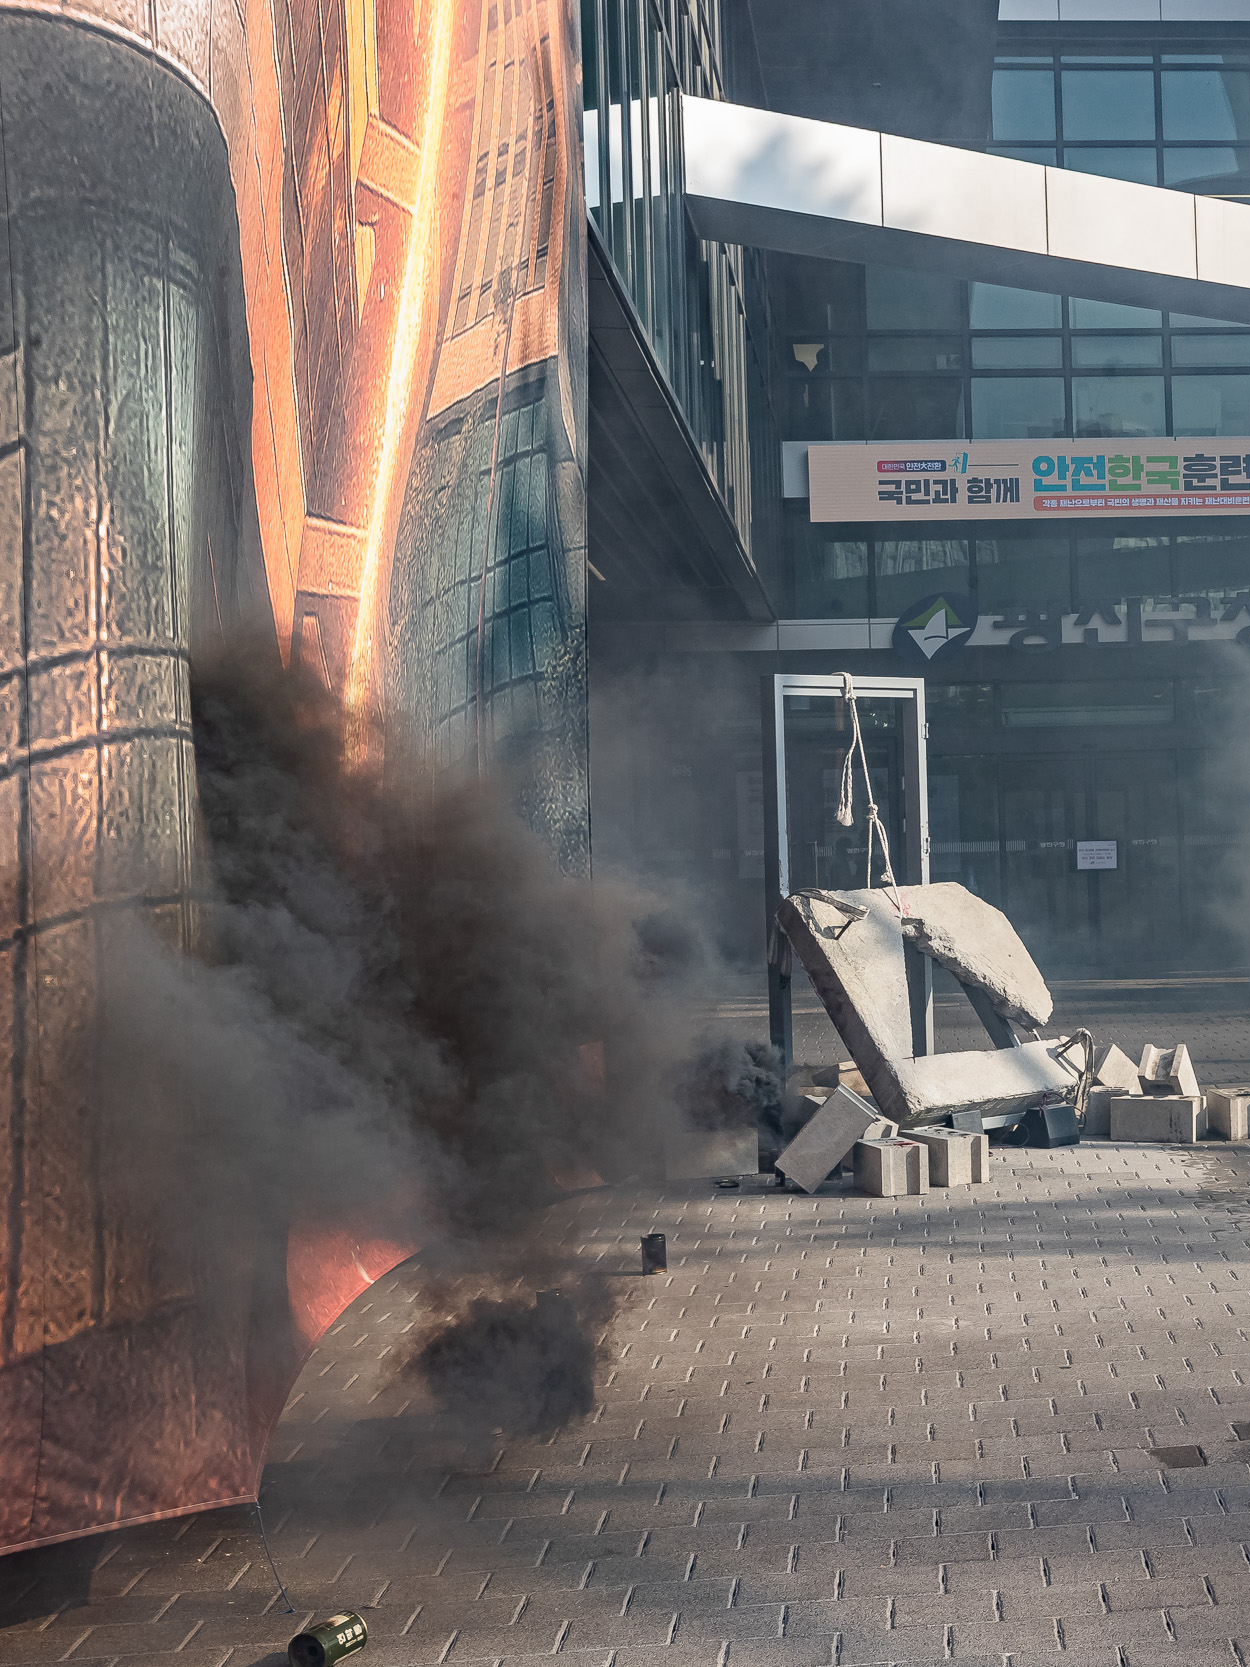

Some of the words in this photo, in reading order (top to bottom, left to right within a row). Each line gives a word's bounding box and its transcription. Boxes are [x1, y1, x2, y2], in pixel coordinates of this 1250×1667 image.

[878, 478, 959, 505] 국민과
[966, 477, 1021, 505] 함께
[1059, 498, 1106, 508] 재난으로부터
[1106, 498, 1130, 507] 국민의
[1131, 497, 1155, 507] 생명과
[1180, 496, 1203, 506] 지키는
[1204, 496, 1250, 505] 재난대비훈련
